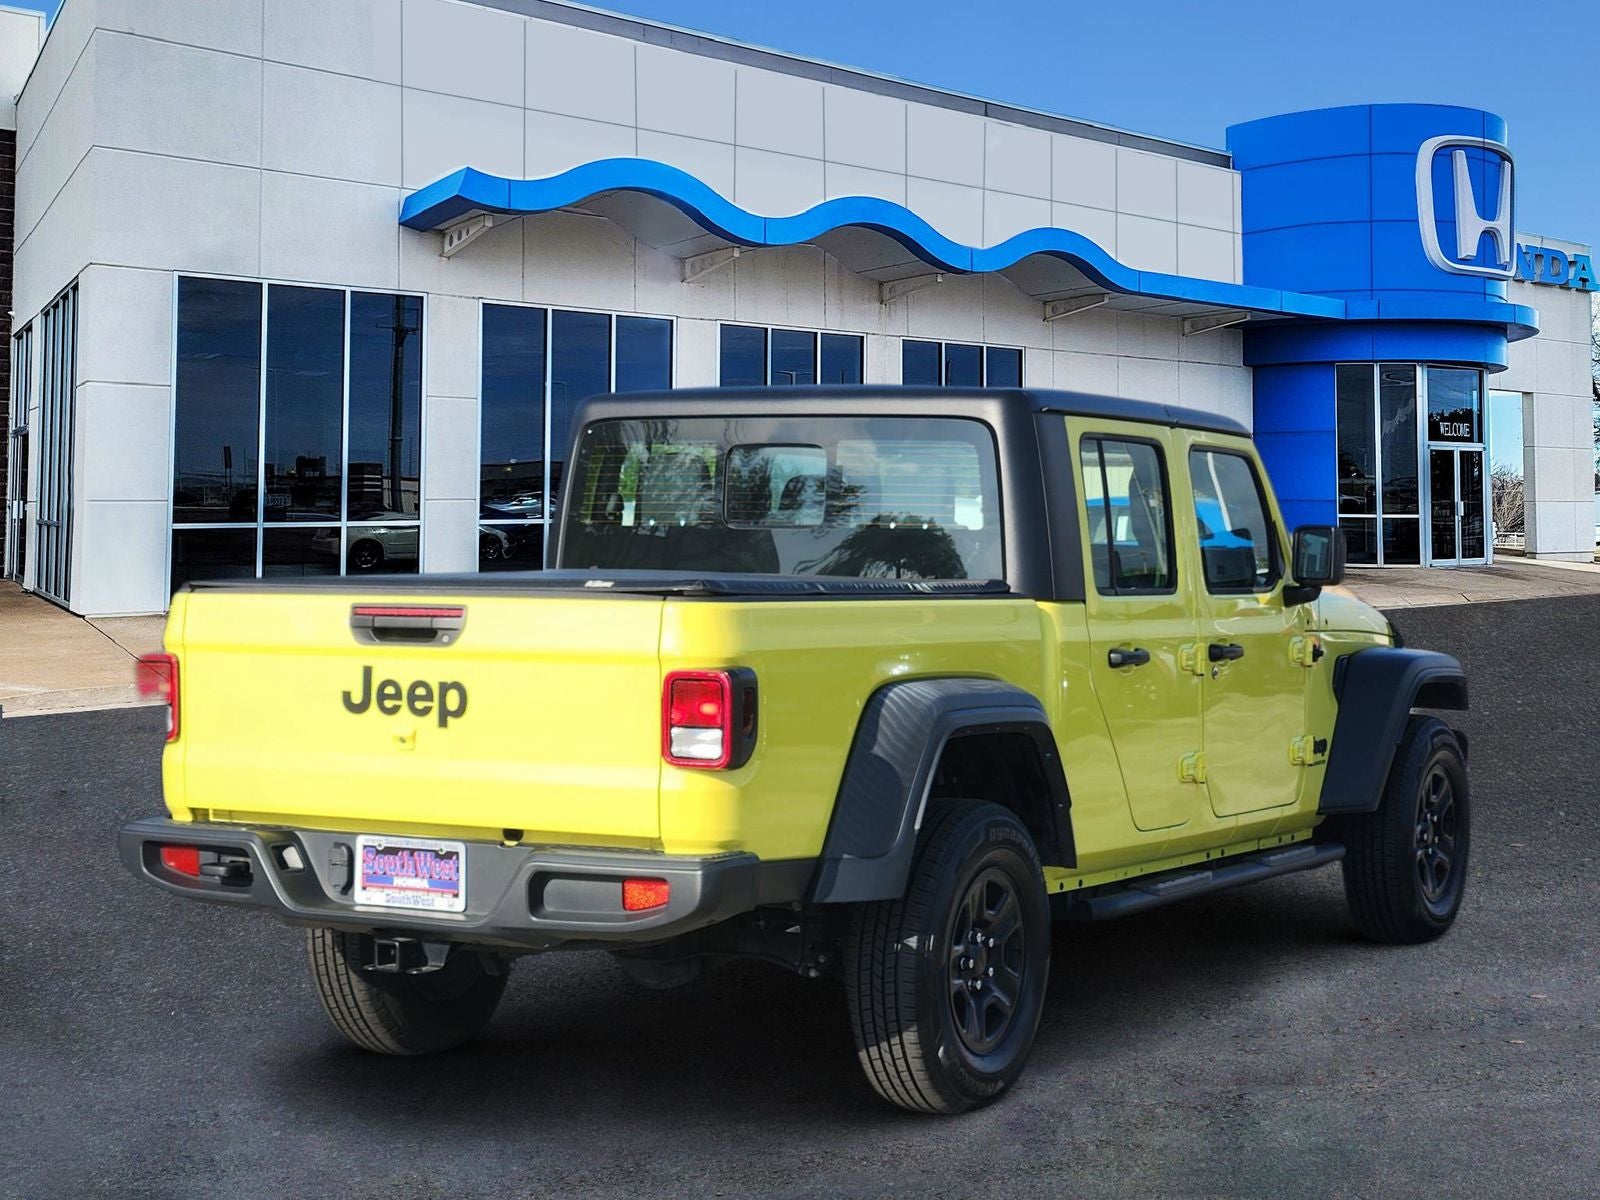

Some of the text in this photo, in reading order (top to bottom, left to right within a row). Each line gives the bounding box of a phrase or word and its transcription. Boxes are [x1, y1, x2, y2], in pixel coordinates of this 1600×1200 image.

[1514, 243, 1600, 291] NDA
[1440, 422, 1470, 437] WELCOME
[342, 665, 468, 729] Jeep
[362, 846, 459, 881] SouthWest
